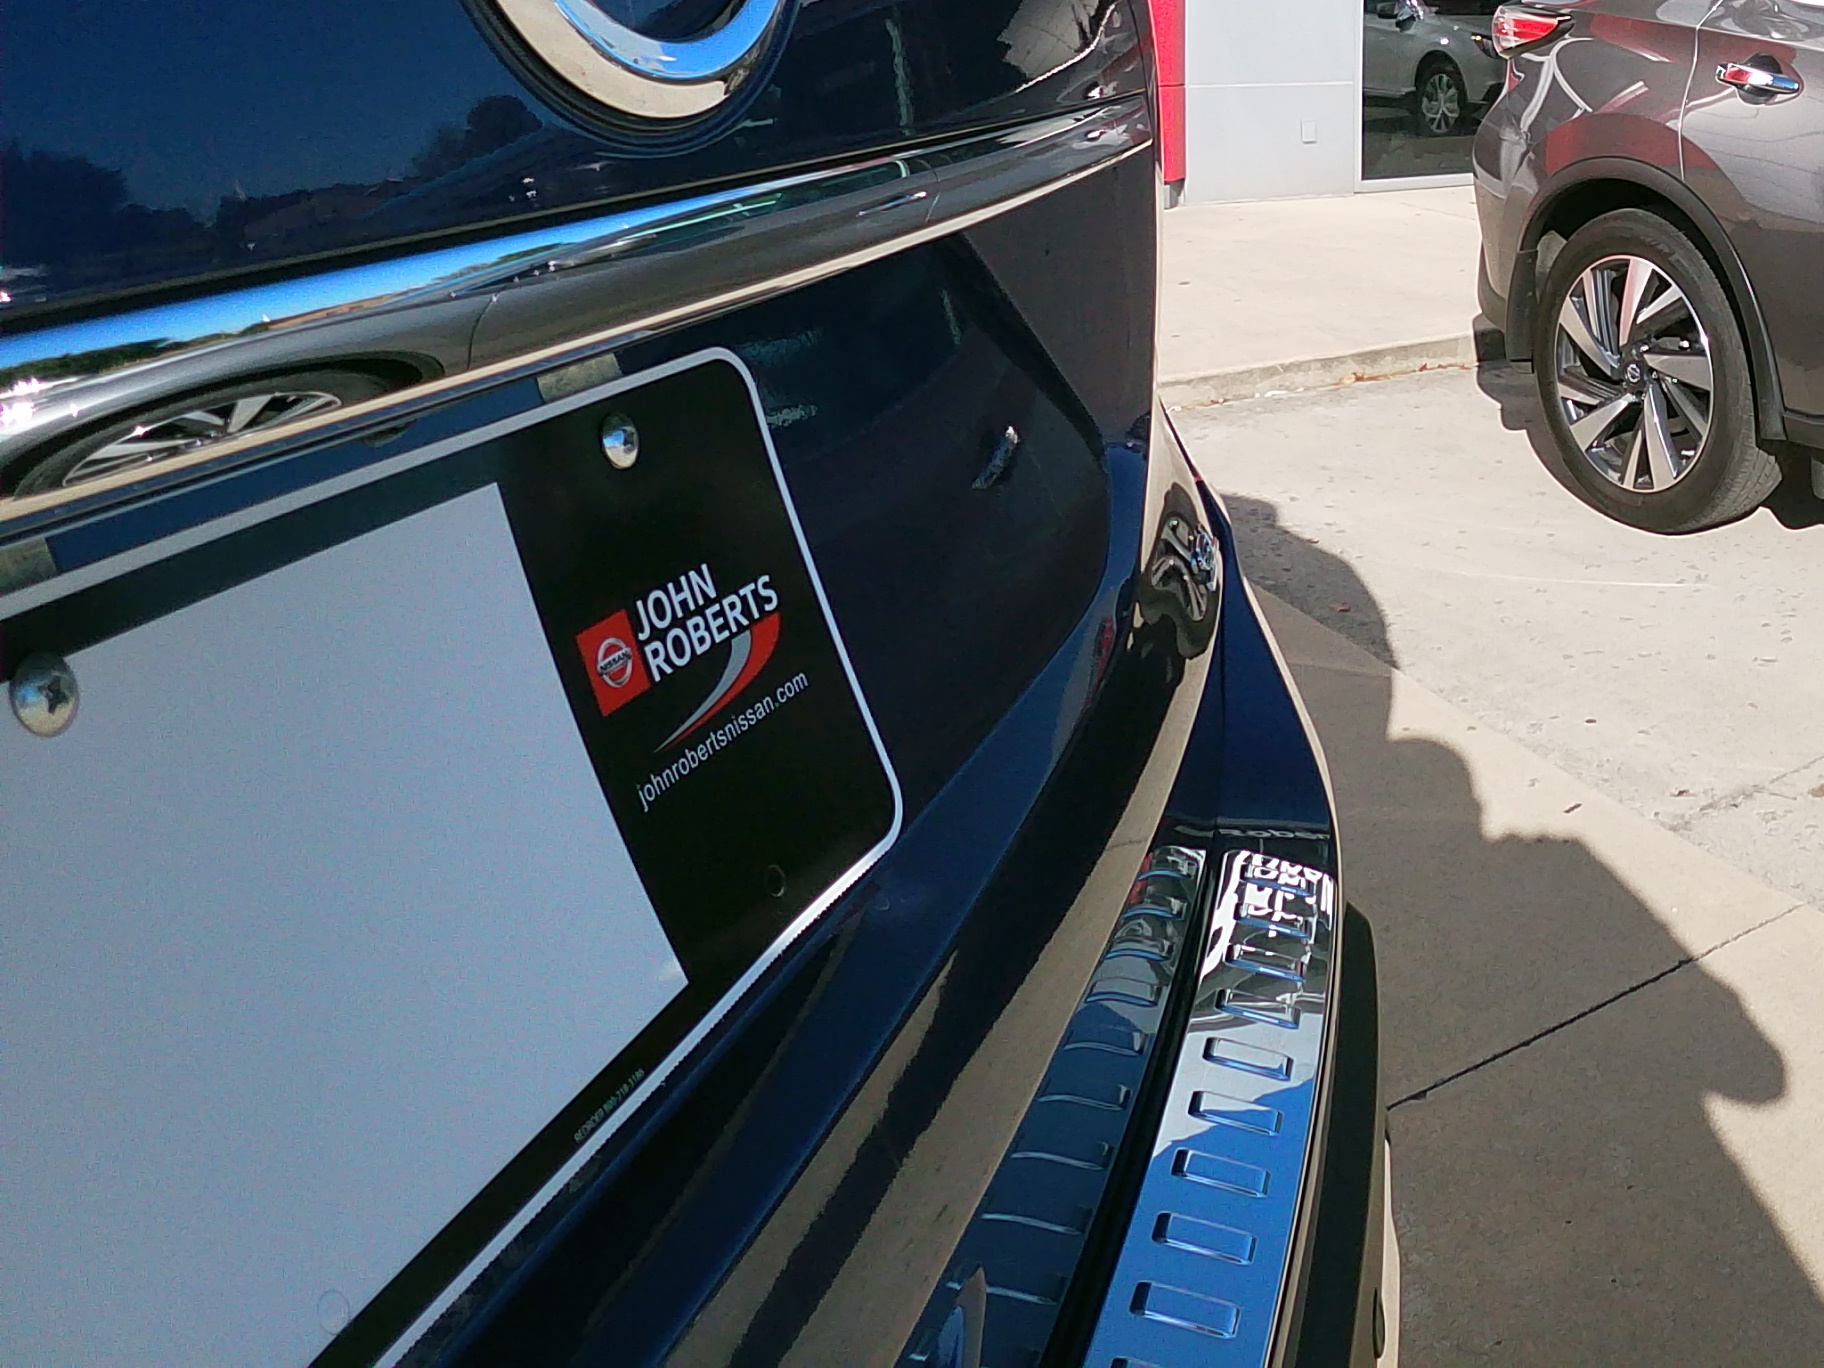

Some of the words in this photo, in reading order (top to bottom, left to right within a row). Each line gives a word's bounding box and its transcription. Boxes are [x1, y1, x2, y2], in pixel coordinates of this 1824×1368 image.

[636, 563, 717, 641] JOHN
[643, 574, 779, 682] ROBERTS
[598, 648, 632, 675] NISSAN
[637, 671, 808, 812] johnrobertsnissan.com
